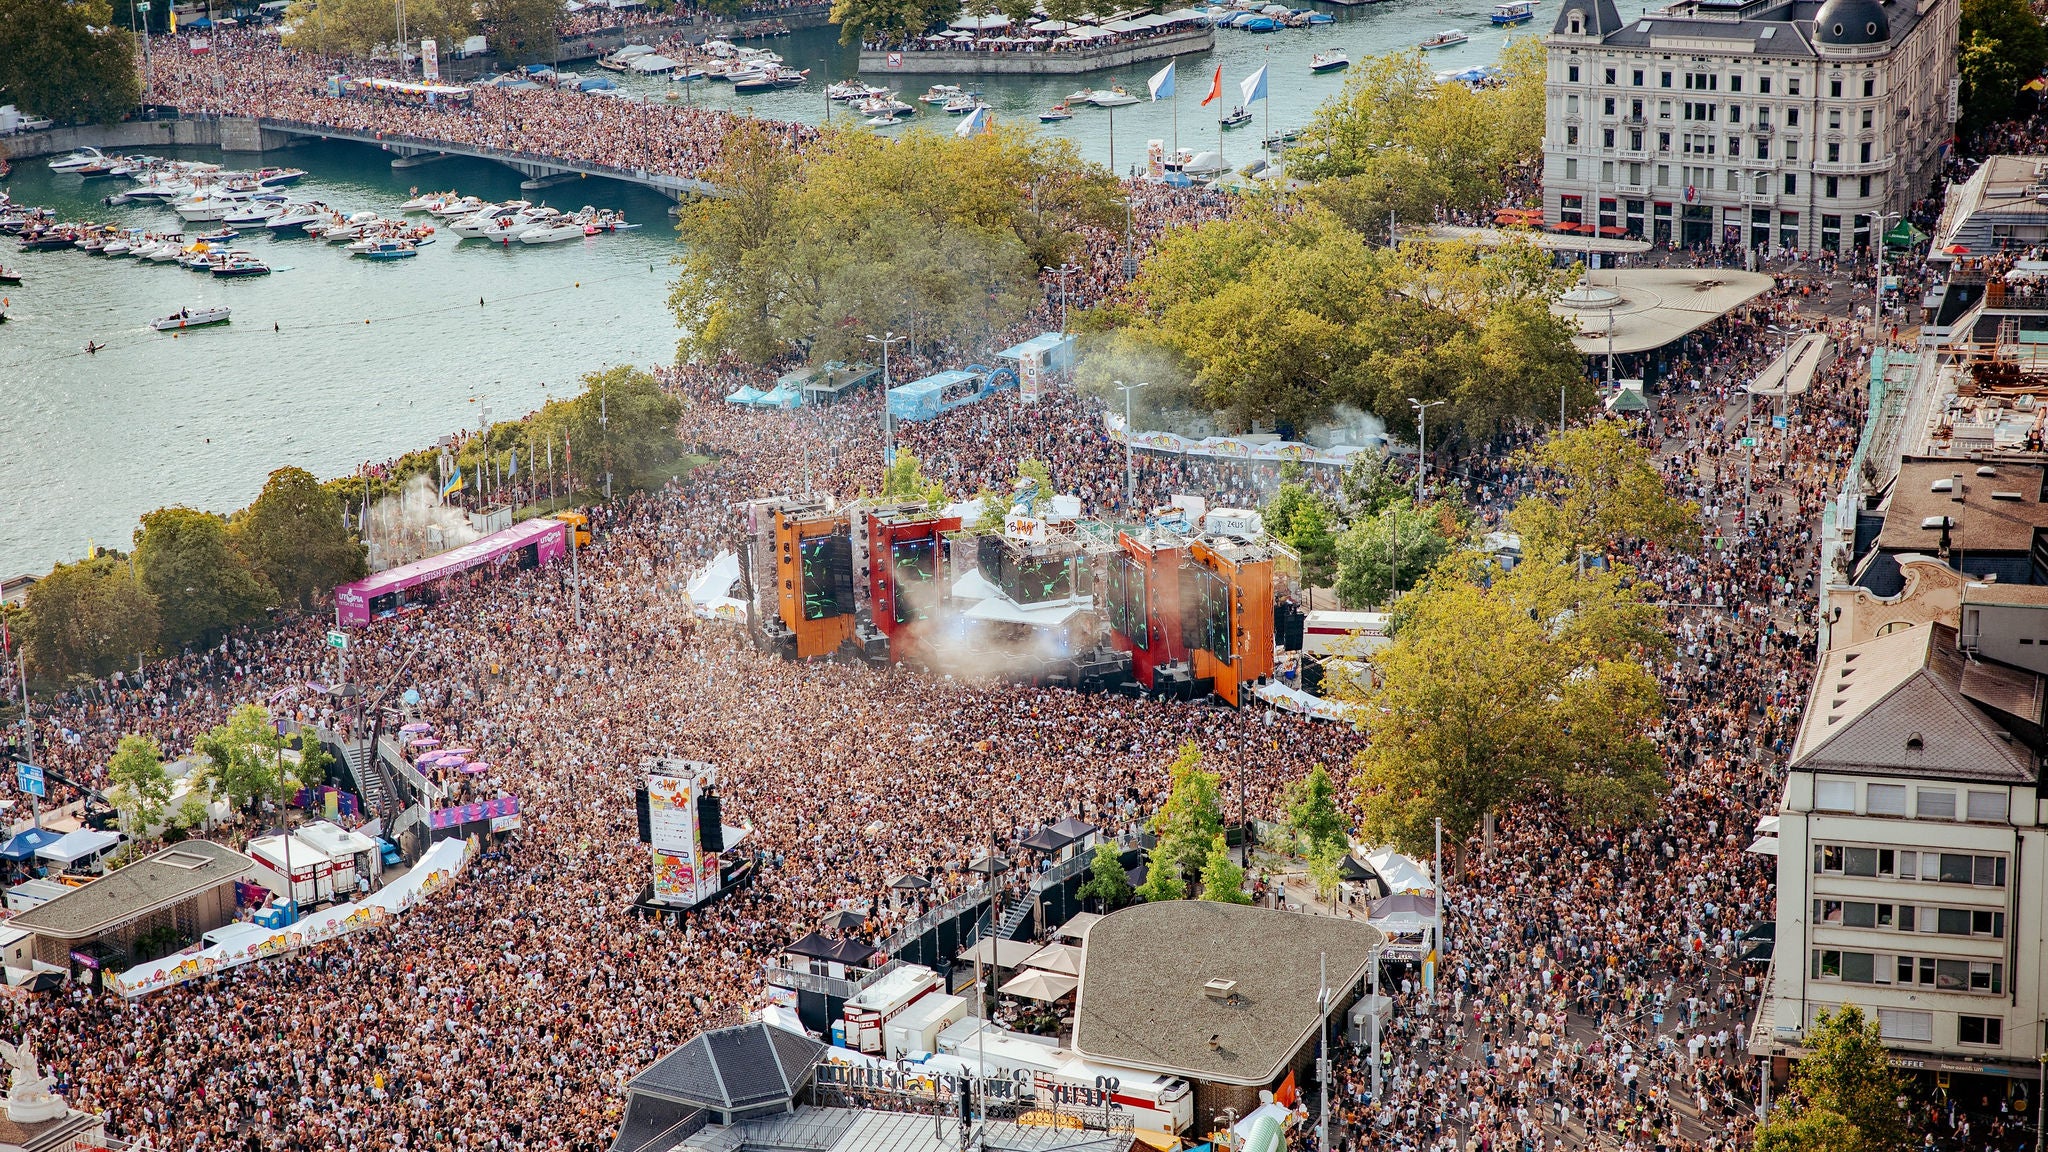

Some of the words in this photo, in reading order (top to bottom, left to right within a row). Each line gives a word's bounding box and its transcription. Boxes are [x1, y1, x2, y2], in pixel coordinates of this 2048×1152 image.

[1227, 520, 1244, 528] ZEUS
[540, 531, 561, 544] UTOPIA
[420, 568, 442, 582] FETISH
[442, 561, 466, 575] FUSION
[338, 592, 364, 603] UTOPIA
[1199, 1077, 1212, 1086] WC
